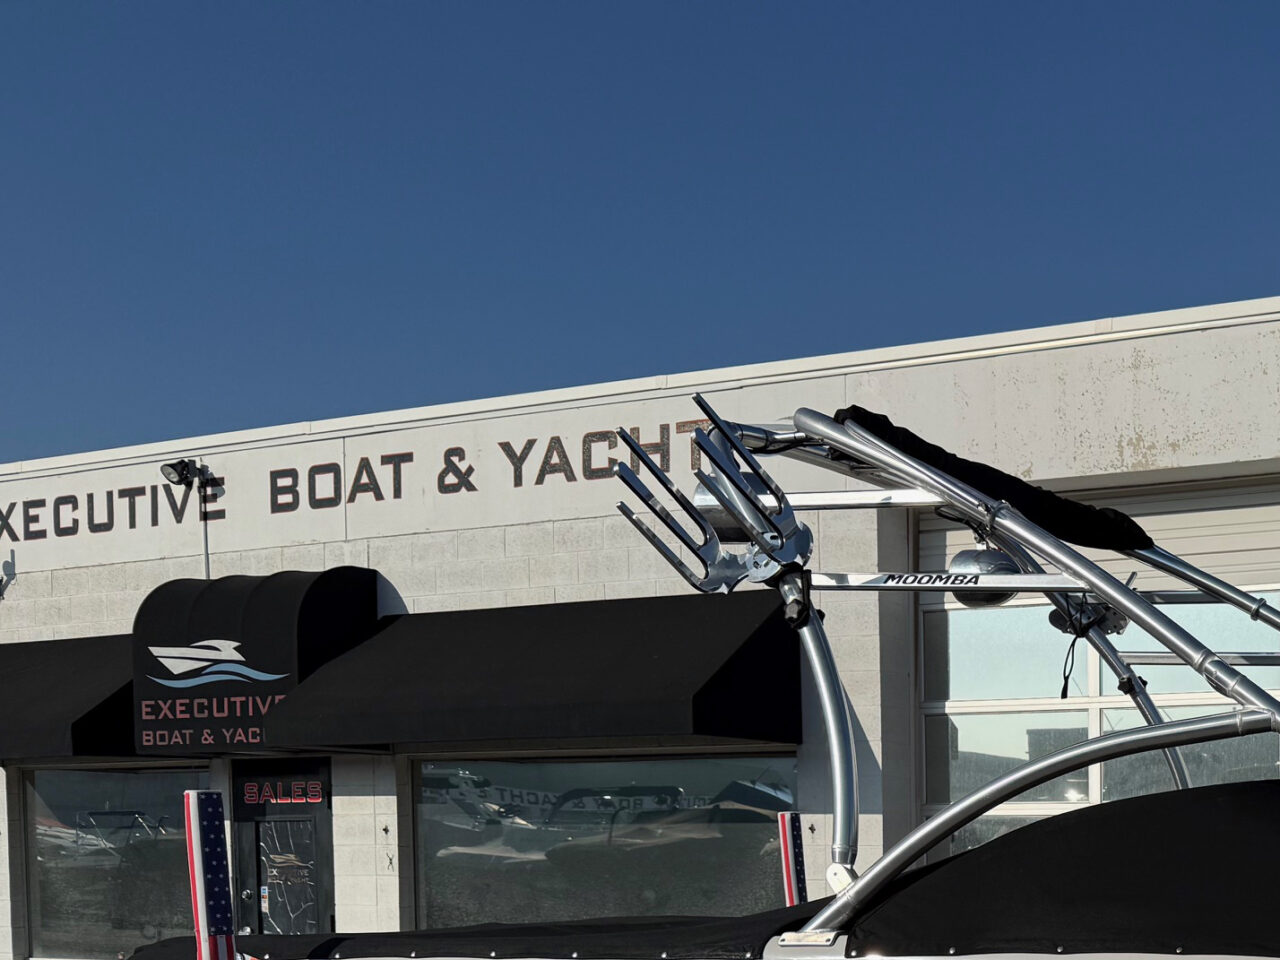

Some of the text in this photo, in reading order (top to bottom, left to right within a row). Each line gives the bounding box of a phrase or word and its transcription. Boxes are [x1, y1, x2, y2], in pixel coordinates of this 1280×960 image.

[270, 452, 414, 514] BOAT
[437, 447, 479, 494] &
[883, 574, 980, 585] MOOMBA
[142, 728, 266, 746] BOAT & YAC
[244, 781, 322, 804] SALES
